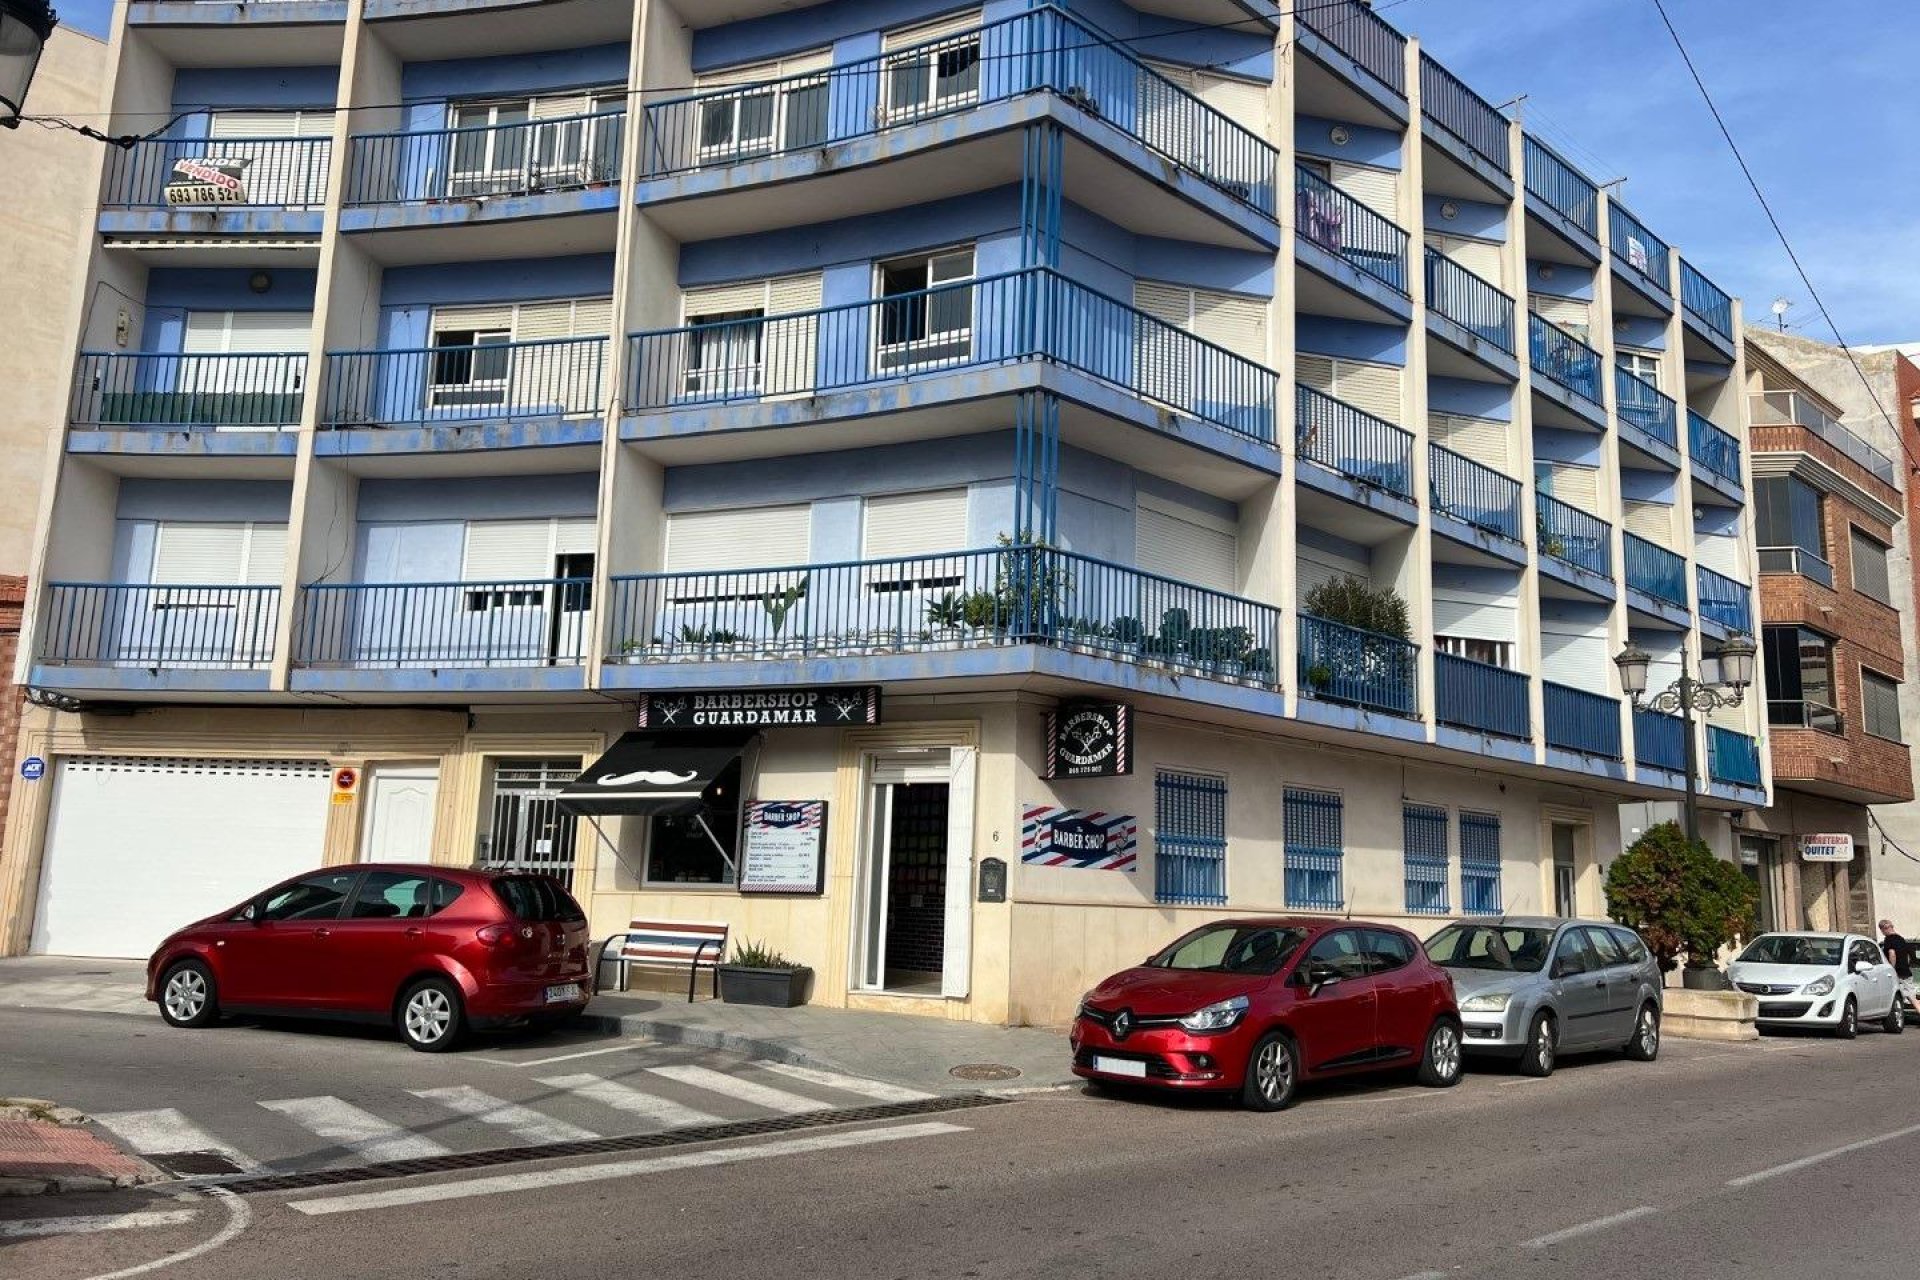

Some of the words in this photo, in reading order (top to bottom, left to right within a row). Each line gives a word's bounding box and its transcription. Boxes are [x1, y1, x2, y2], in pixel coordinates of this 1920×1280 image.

[178, 162, 239, 189] VENDIDO
[170, 188, 190, 203] 693
[193, 187, 215, 202] 786
[693, 692, 818, 709] BARBERSHOP
[693, 709, 817, 725] GUARDAMAR
[1060, 711, 1114, 741] BARBERSHOP
[1060, 743, 1114, 765] GUARDAMAR
[993, 831, 999, 841] 6
[1054, 828, 1084, 849] BARBER
[1085, 833, 1105, 850] SHOP
[1804, 846, 1835, 856] QUITET
